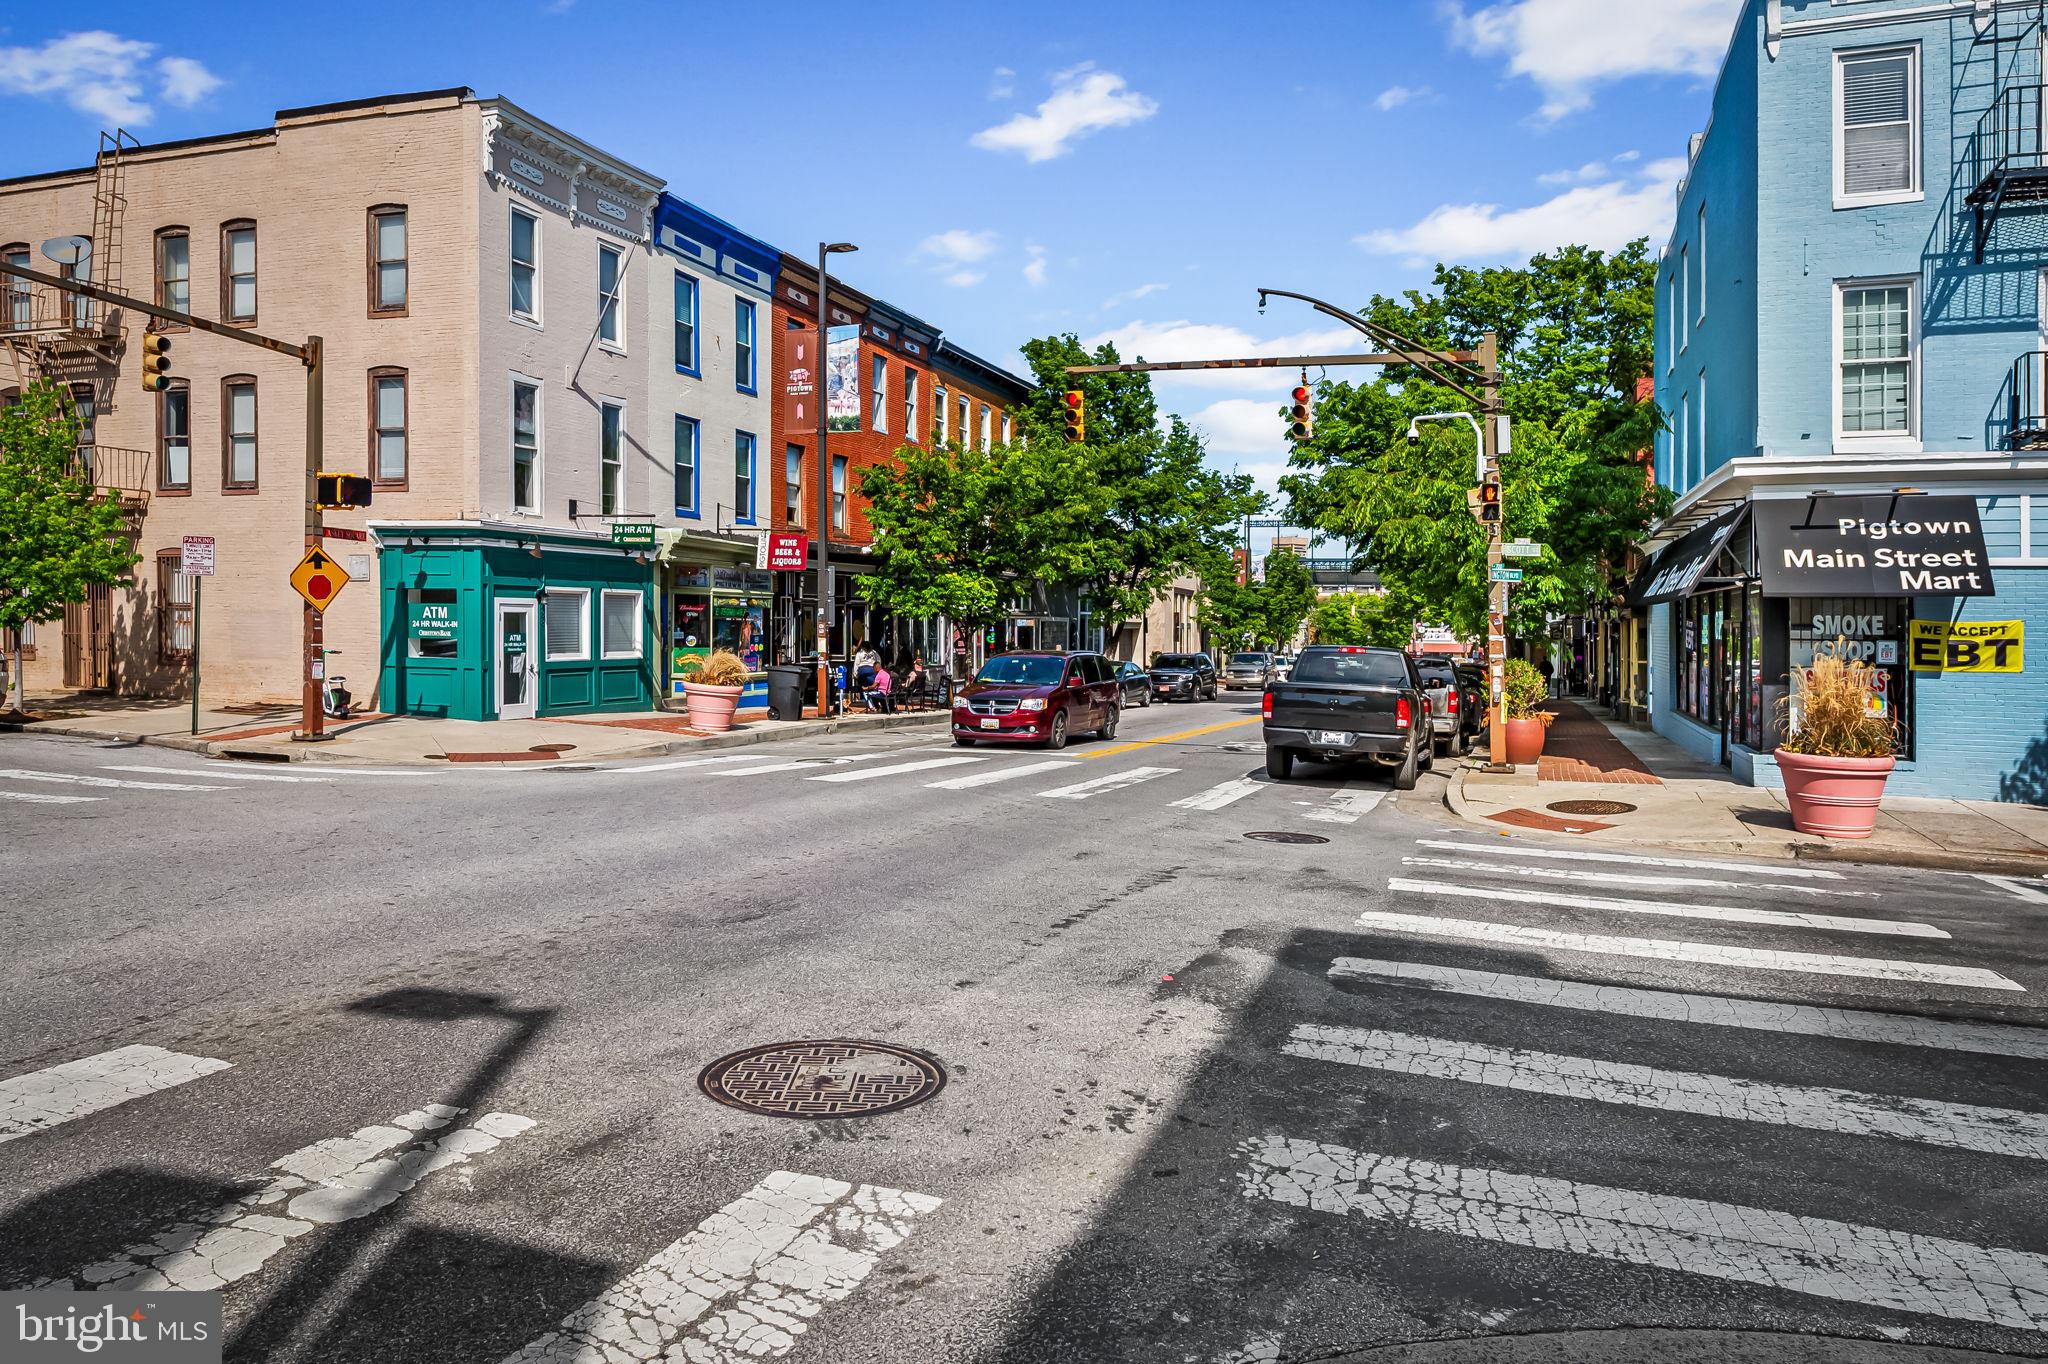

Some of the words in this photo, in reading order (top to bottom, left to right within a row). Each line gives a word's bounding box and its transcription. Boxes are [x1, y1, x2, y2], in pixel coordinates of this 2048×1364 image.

[614, 526, 623, 534] 24
[624, 526, 636, 534] HR
[636, 526, 652, 534] ATM
[1838, 518, 1971, 540] Pigtown
[184, 536, 214, 544] PARKING
[1507, 545, 1529, 554] SCOTT
[772, 558, 801, 566] LIQUORS
[1783, 549, 1865, 568] Main
[1874, 548, 1978, 568] Street
[1899, 570, 1982, 590] Mart
[423, 606, 448, 619] ATM
[1812, 615, 1885, 635] SMOKE
[1920, 624, 1942, 635] WE
[1947, 625, 2009, 636] ACCEPT
[1821, 640, 1875, 660] SHOP
[1913, 637, 2019, 667] EBT
